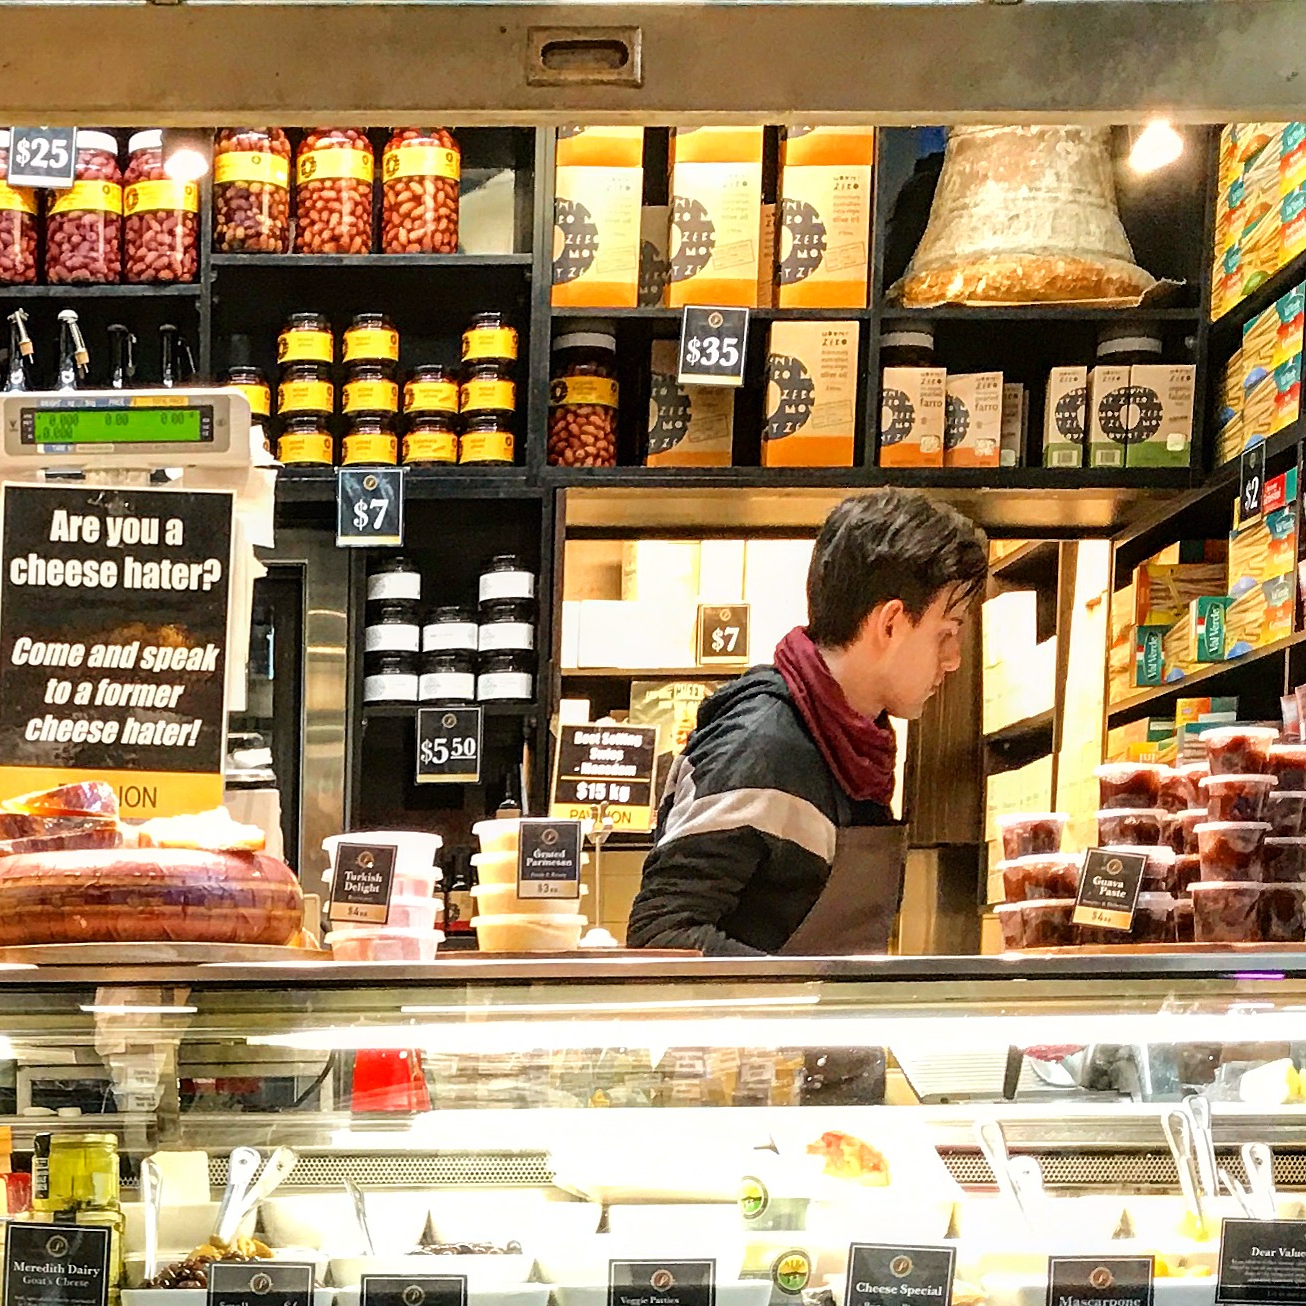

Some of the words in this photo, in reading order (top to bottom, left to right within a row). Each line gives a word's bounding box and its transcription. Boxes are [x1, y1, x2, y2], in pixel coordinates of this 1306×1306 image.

[16, 137, 69, 169] $25
[686, 336, 740, 367] $35
[920, 398, 943, 408] farro
[975, 402, 998, 412] farro
[1245, 476, 1259, 510] $2
[353, 498, 389, 530] $7
[50, 509, 100, 543] Are
[106, 515, 160, 547] you
[165, 518, 184, 546] a
[9, 553, 118, 588] cheese
[123, 556, 222, 591] hater?
[1209, 606, 1220, 637] Verde
[711, 625, 740, 653] $7
[1209, 638, 1219, 653] Val
[11, 636, 84, 667] Come
[87, 641, 141, 669] and
[140, 643, 220, 673] speak
[44, 678, 73, 705] to
[74, 681, 94, 706] a
[94, 678, 186, 709] former
[25, 714, 120, 745] cheese
[120, 718, 202, 748] hater!
[576, 781, 606, 801] $15
[608, 783, 631, 803] kg
[526, 857, 573, 867] Parmesan
[533, 848, 566, 859] Grated
[344, 871, 382, 883] Turkish
[1093, 875, 1124, 889] Guava
[344, 882, 380, 895] Delight
[1099, 886, 1127, 899] Paste
[1251, 1246, 1277, 1257] Dear
[13, 1261, 65, 1274] Meredith
[67, 1264, 101, 1278] Dairy
[55, 1276, 90, 1287] Cheese
[856, 1282, 898, 1294] Cheese
[899, 1284, 943, 1297] Special
